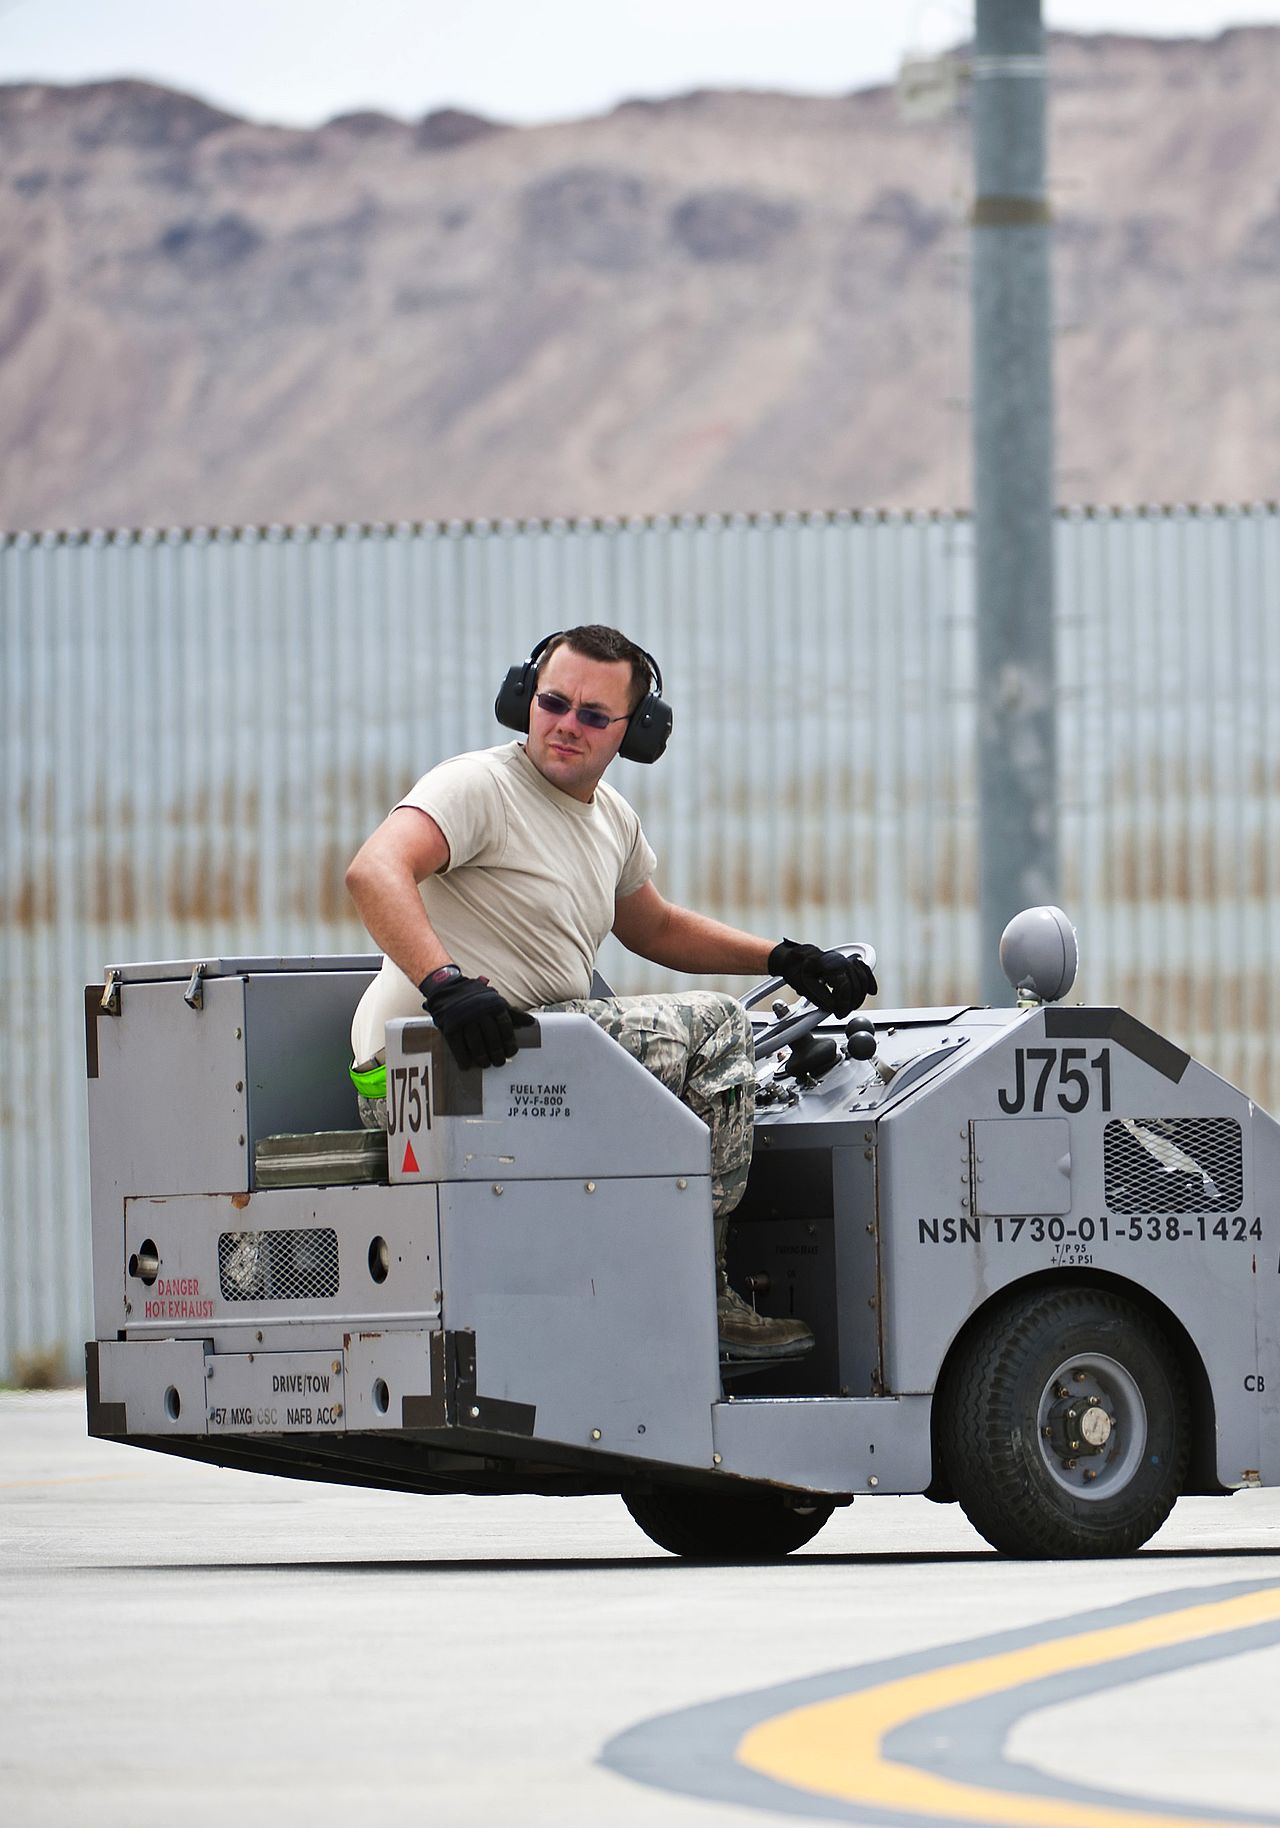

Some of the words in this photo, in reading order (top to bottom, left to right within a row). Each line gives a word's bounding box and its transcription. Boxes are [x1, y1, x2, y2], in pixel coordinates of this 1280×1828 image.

[510, 1084, 534, 1094] FUEL
[537, 1084, 567, 1094] TANK
[998, 1048, 1111, 1114] J751
[387, 1066, 431, 1136] J751
[514, 1096, 563, 1106] VV-F-800
[508, 1107, 519, 1117] JP
[522, 1107, 528, 1117] 4
[531, 1107, 546, 1117] OR
[550, 1108, 561, 1117] JP
[564, 1108, 571, 1117] 8
[918, 1217, 981, 1244] NSN
[994, 1216, 1262, 1243] 1730-01-538-1424
[1055, 1243, 1071, 1254] T/P
[1074, 1244, 1086, 1253] 95
[1078, 1255, 1092, 1264] PSI
[158, 1279, 199, 1296] DANGER
[145, 1301, 165, 1318] HOT
[168, 1301, 214, 1318] EXHAUST
[272, 1373, 330, 1396] DRIVE/TOW
[1244, 1375, 1265, 1392] CB
[231, 1408, 252, 1425] MXG
[287, 1408, 312, 1425] NAFB
[316, 1408, 338, 1425] ACC
